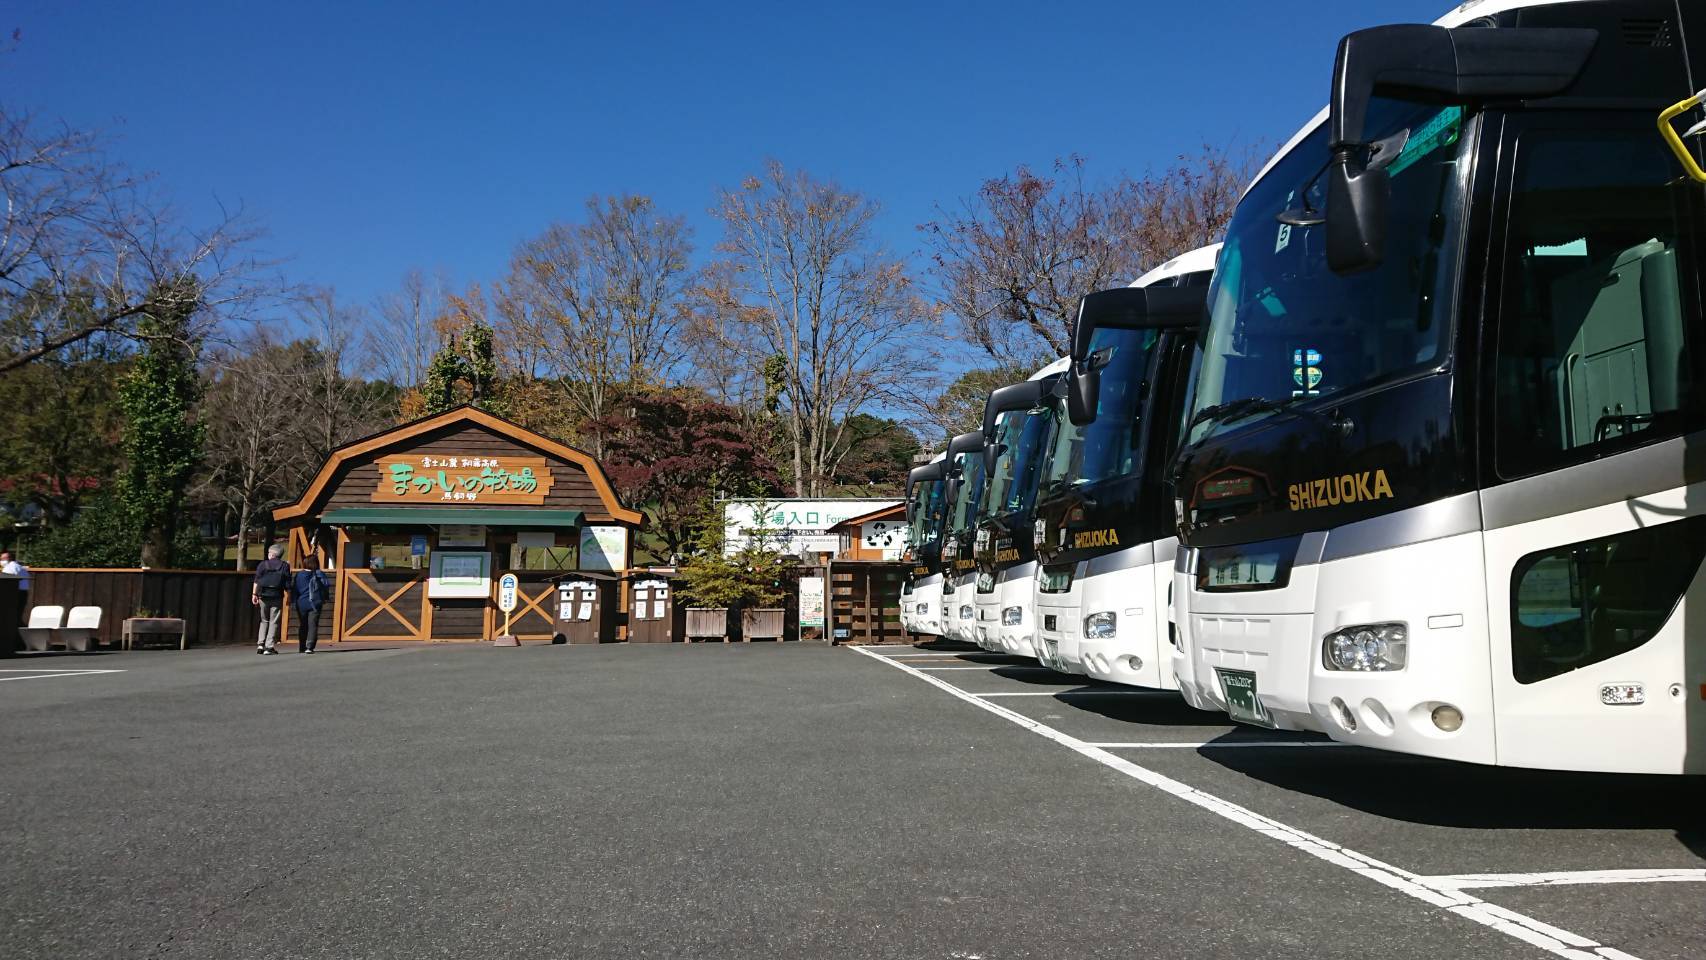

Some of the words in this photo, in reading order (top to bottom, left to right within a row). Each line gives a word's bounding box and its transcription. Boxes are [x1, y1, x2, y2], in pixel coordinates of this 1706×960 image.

[389, 463, 537, 495] まかいの牧場
[1289, 469, 1394, 511] SHIZUOKA
